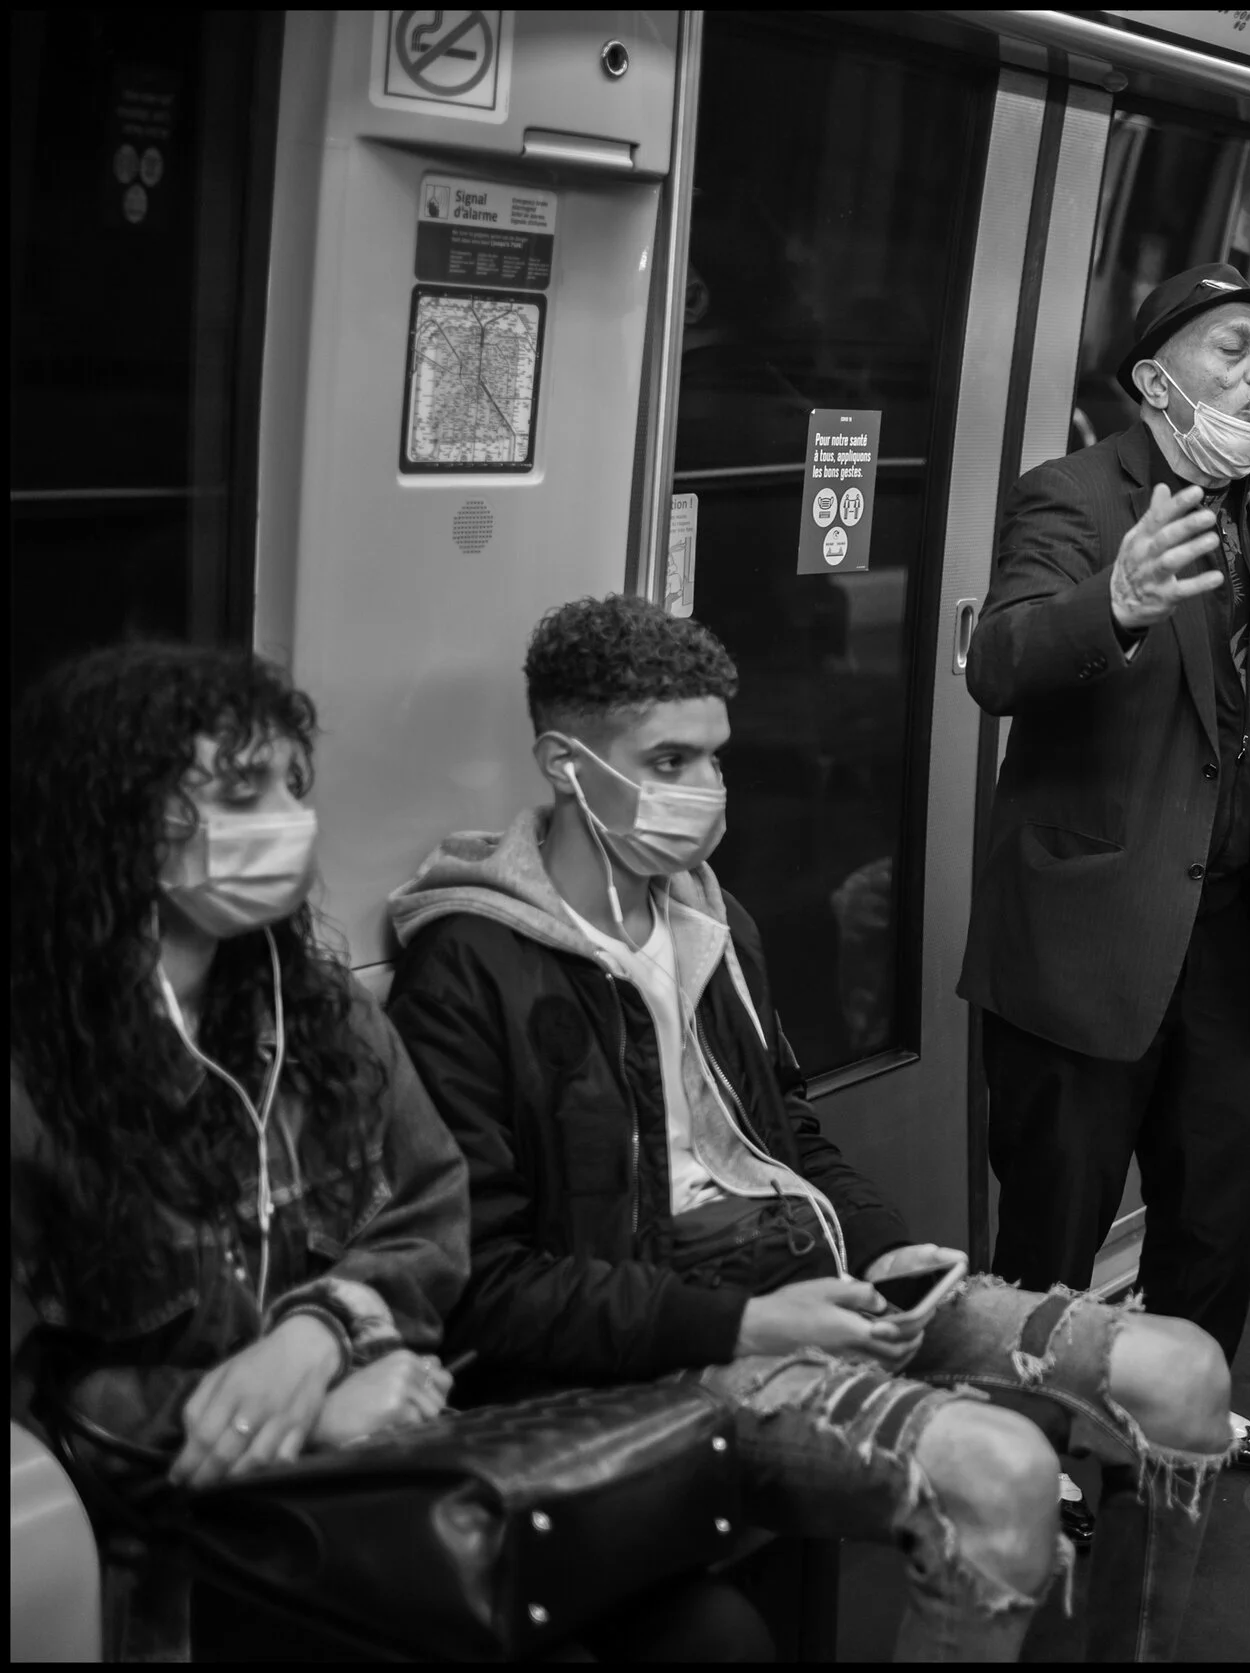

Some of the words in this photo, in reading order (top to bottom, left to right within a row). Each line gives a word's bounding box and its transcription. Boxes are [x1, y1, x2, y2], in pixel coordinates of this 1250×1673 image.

[455, 189, 488, 207] Signal
[453, 205, 499, 222] d'alarme
[815, 432, 831, 446] Pour
[831, 433, 849, 446] notre
[849, 433, 868, 447] santé
[813, 449, 819, 462] à
[819, 449, 836, 463] tous,
[837, 449, 872, 465] appliquons
[812, 464, 823, 478] les
[823, 464, 840, 478] bons
[840, 464, 864, 481] gestes.
